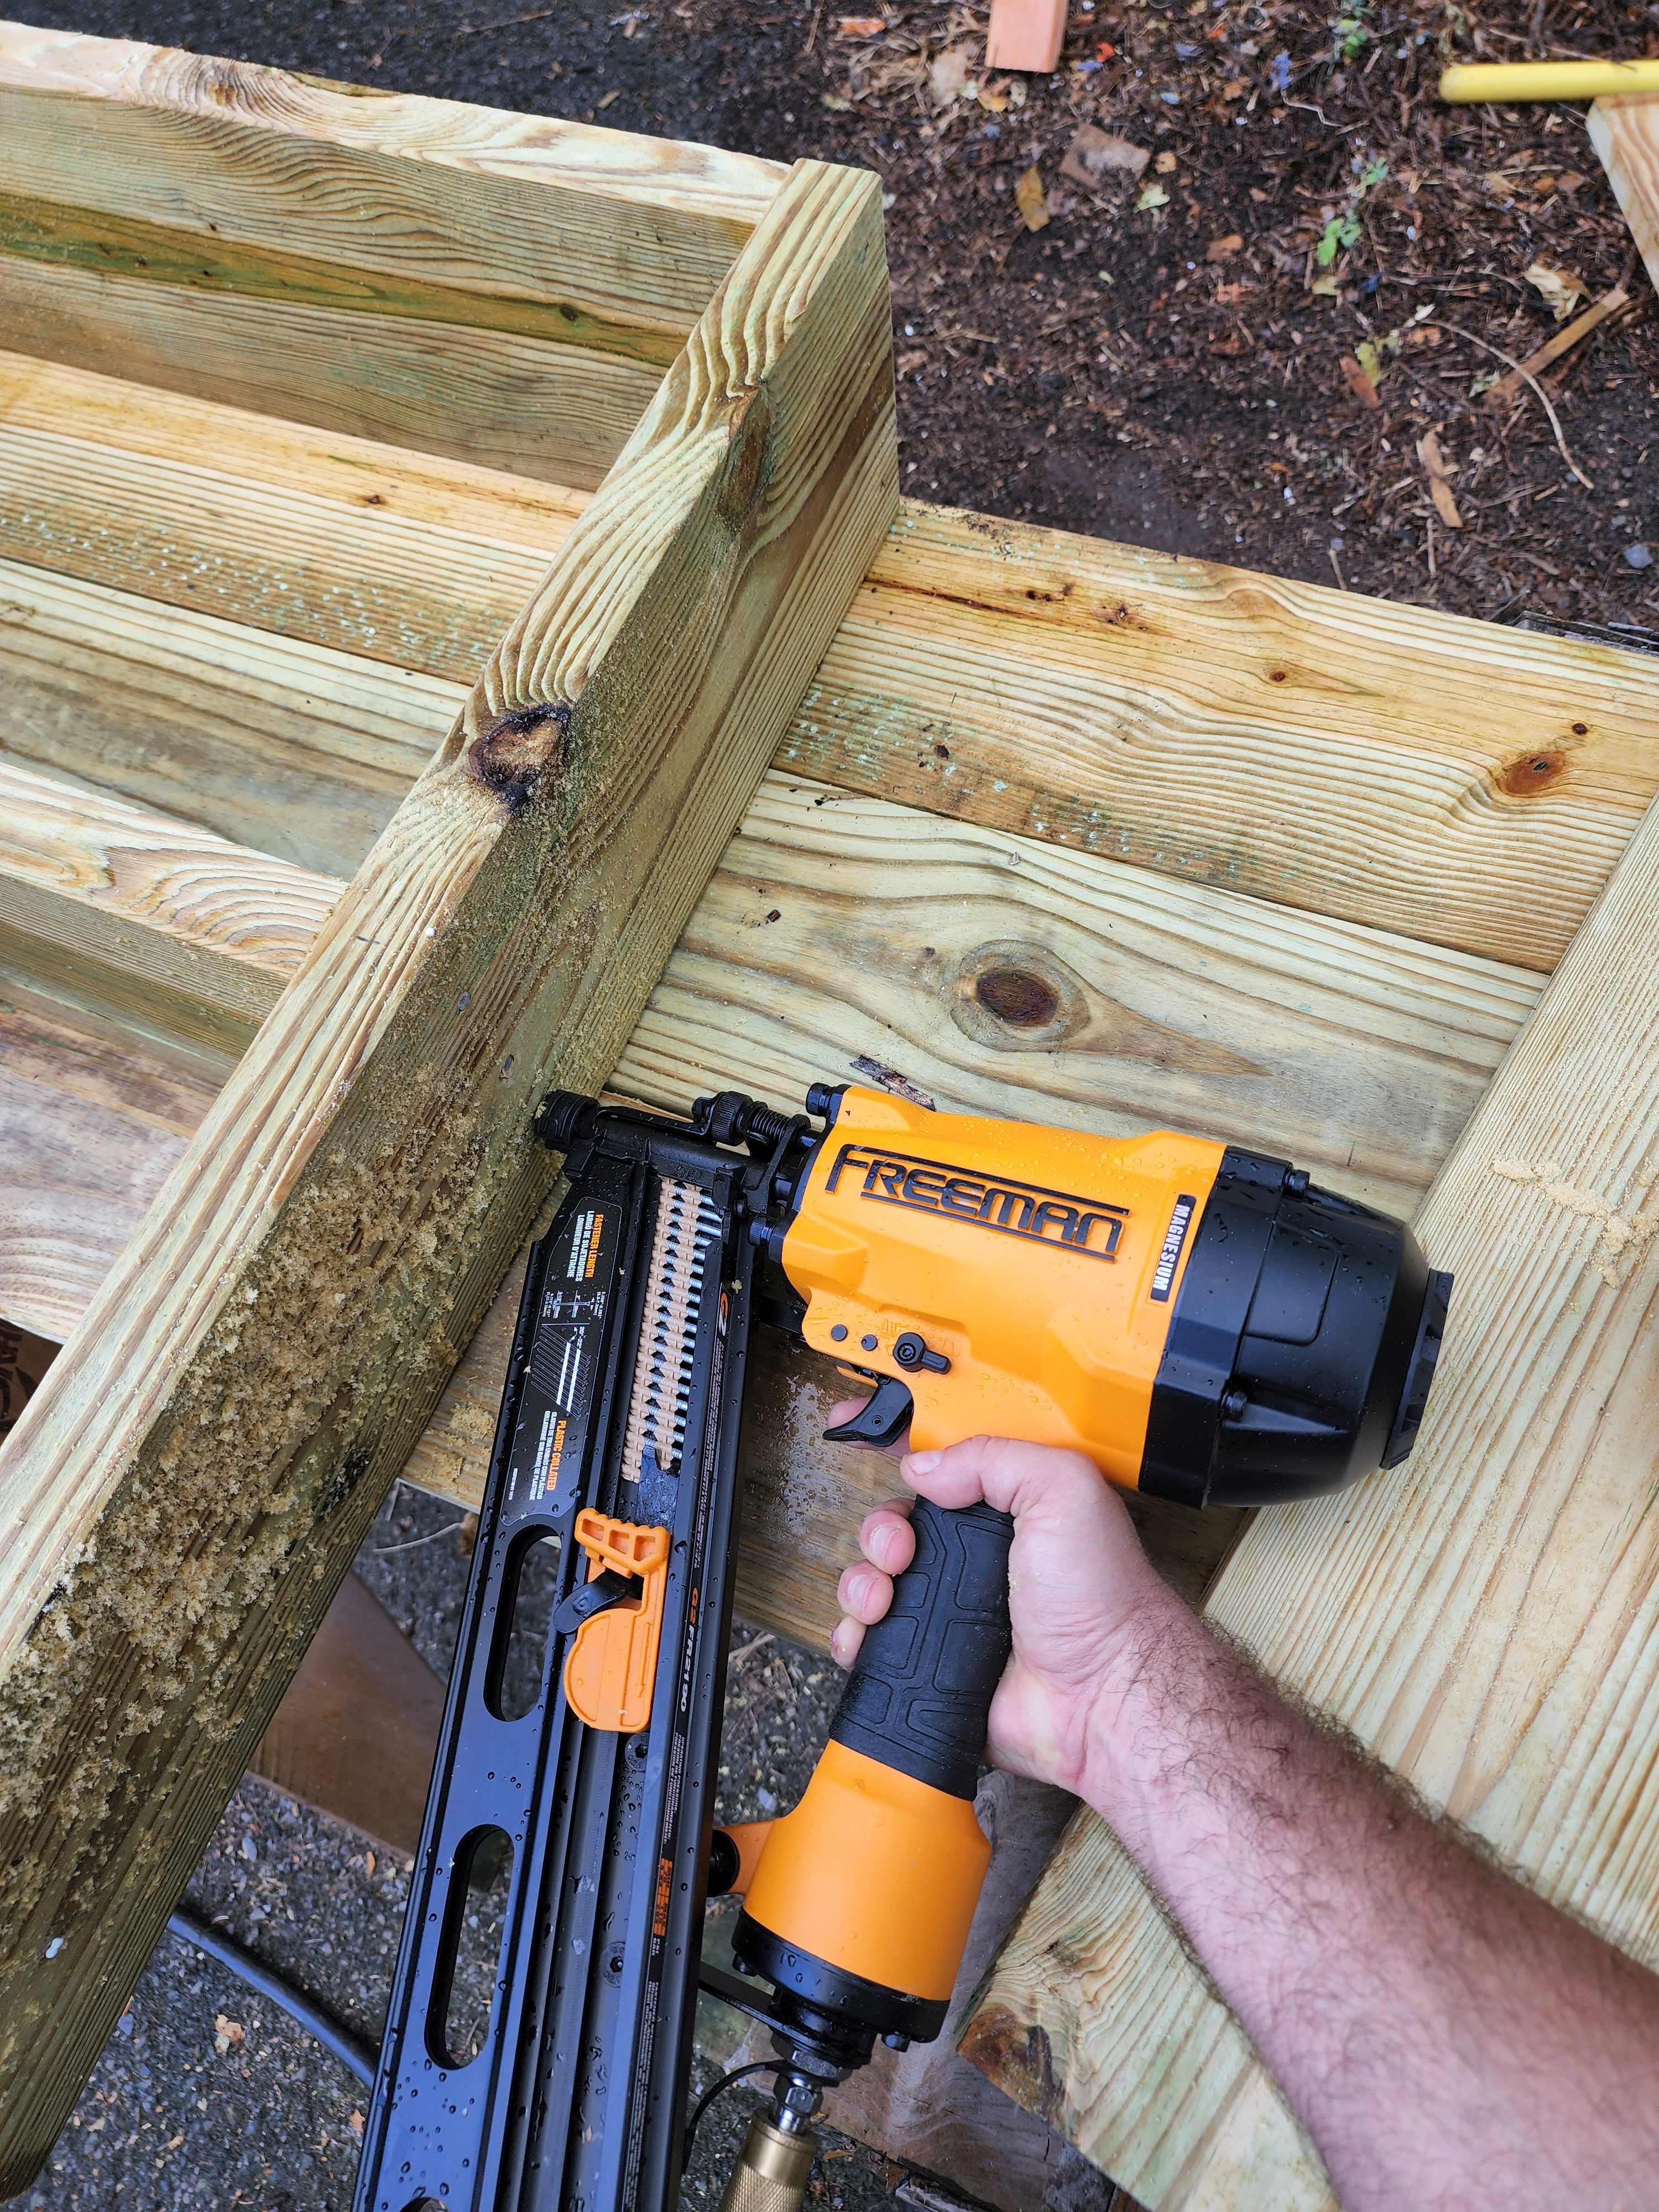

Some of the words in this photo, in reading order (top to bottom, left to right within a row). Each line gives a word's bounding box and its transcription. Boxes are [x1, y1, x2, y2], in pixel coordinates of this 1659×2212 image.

[676, 1165, 703, 1182] 2190
[825, 1143, 1130, 1254] FREEMAN
[573, 1215, 585, 1245] LONGUEUR
[585, 1211, 594, 1230] LARGO
[590, 1214, 603, 1249] FASTENER
[567, 1246, 579, 1277] D'ATTACHE
[575, 1240, 589, 1281] SUJETADORES
[1152, 1204, 1190, 1291] MAGNESIUM
[585, 1250, 597, 1277] LENGTH
[554, 1421, 566, 1451] PLASTIC
[542, 1448, 551, 1465] UNIDOS
[546, 1453, 561, 1490] COLLATED
[529, 1475, 539, 1500] PLASTIQUE
